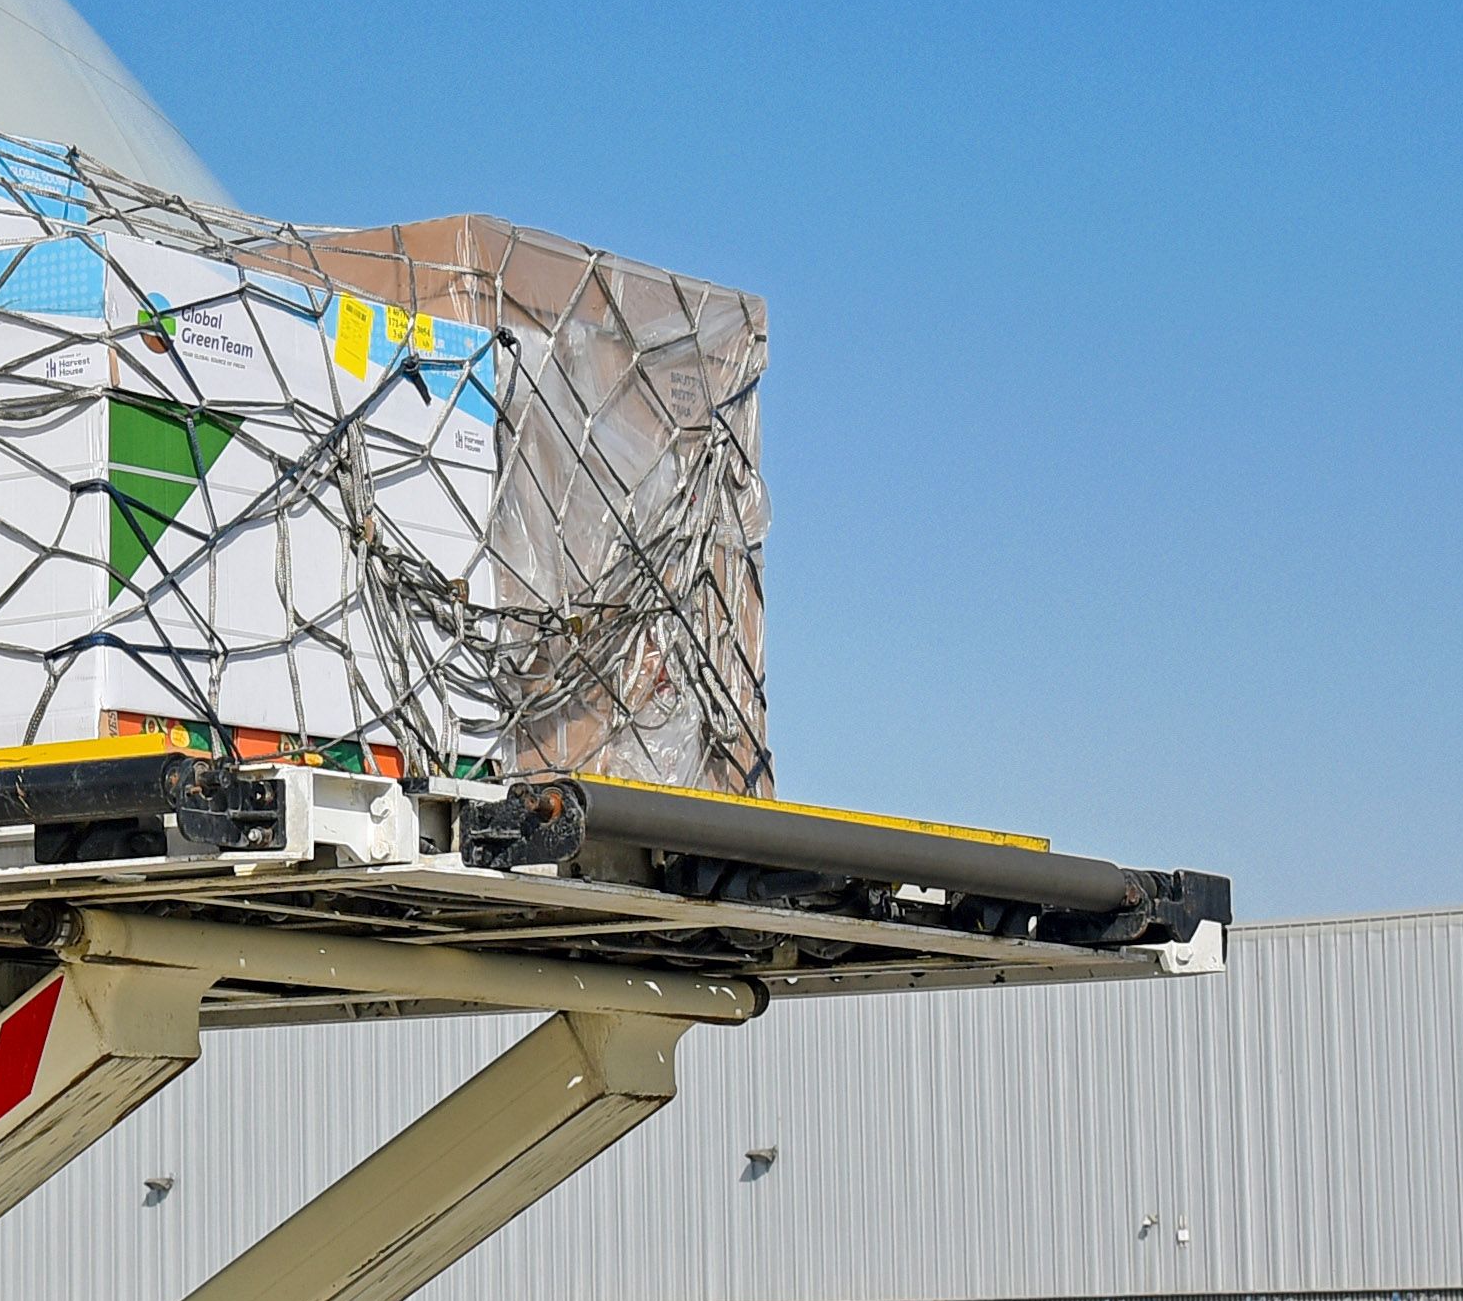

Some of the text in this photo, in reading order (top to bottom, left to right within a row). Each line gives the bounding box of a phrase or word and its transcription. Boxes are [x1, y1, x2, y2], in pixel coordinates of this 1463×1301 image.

[181, 306, 223, 330] Global
[58, 356, 91, 369] Harvest
[58, 366, 84, 378] House
